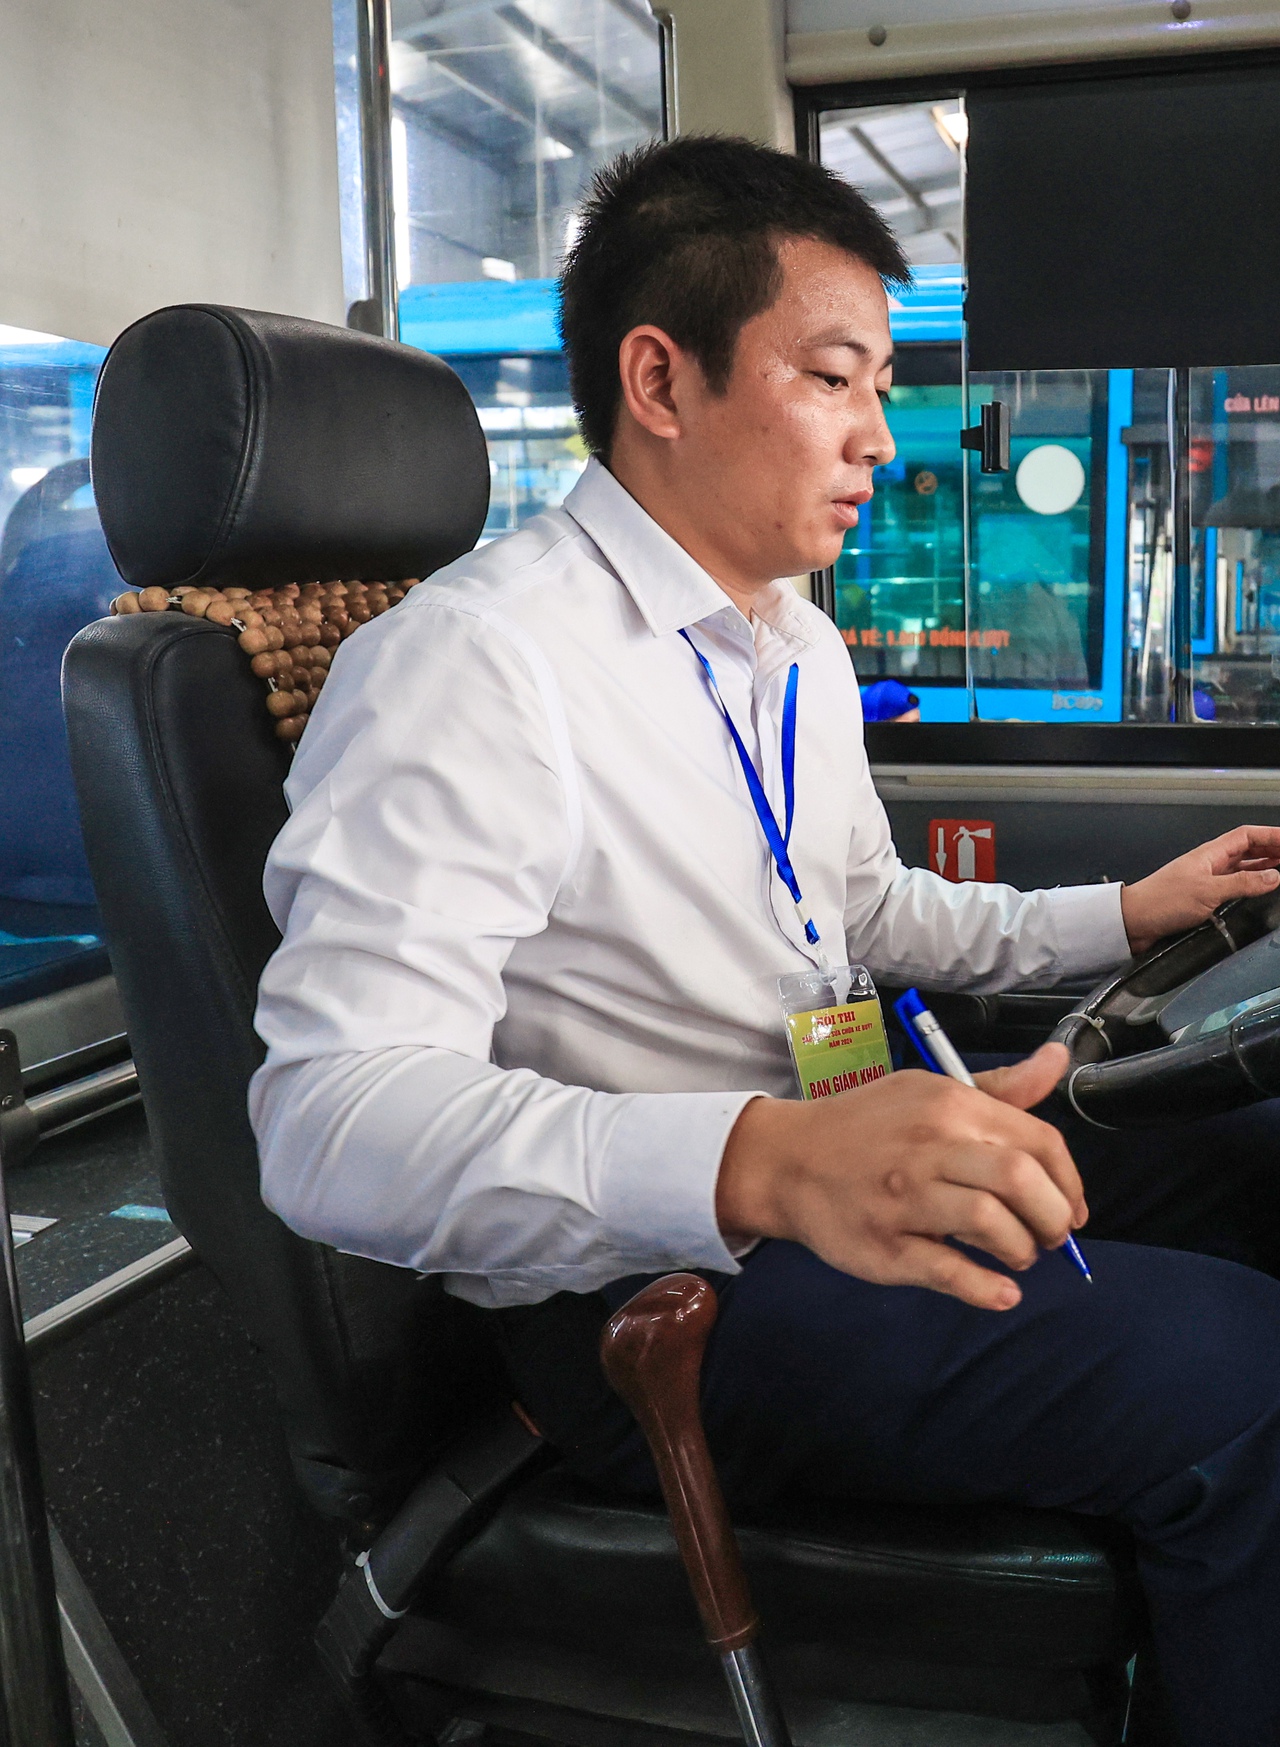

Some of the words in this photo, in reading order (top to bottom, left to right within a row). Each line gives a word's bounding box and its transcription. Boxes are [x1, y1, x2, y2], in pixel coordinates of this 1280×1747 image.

[837, 1011, 856, 1024] THI
[855, 1024, 862, 1033] XE
[809, 1078, 832, 1100] BAN
[832, 1069, 859, 1094] GIÁM
[859, 1060, 886, 1086] KHẢO
